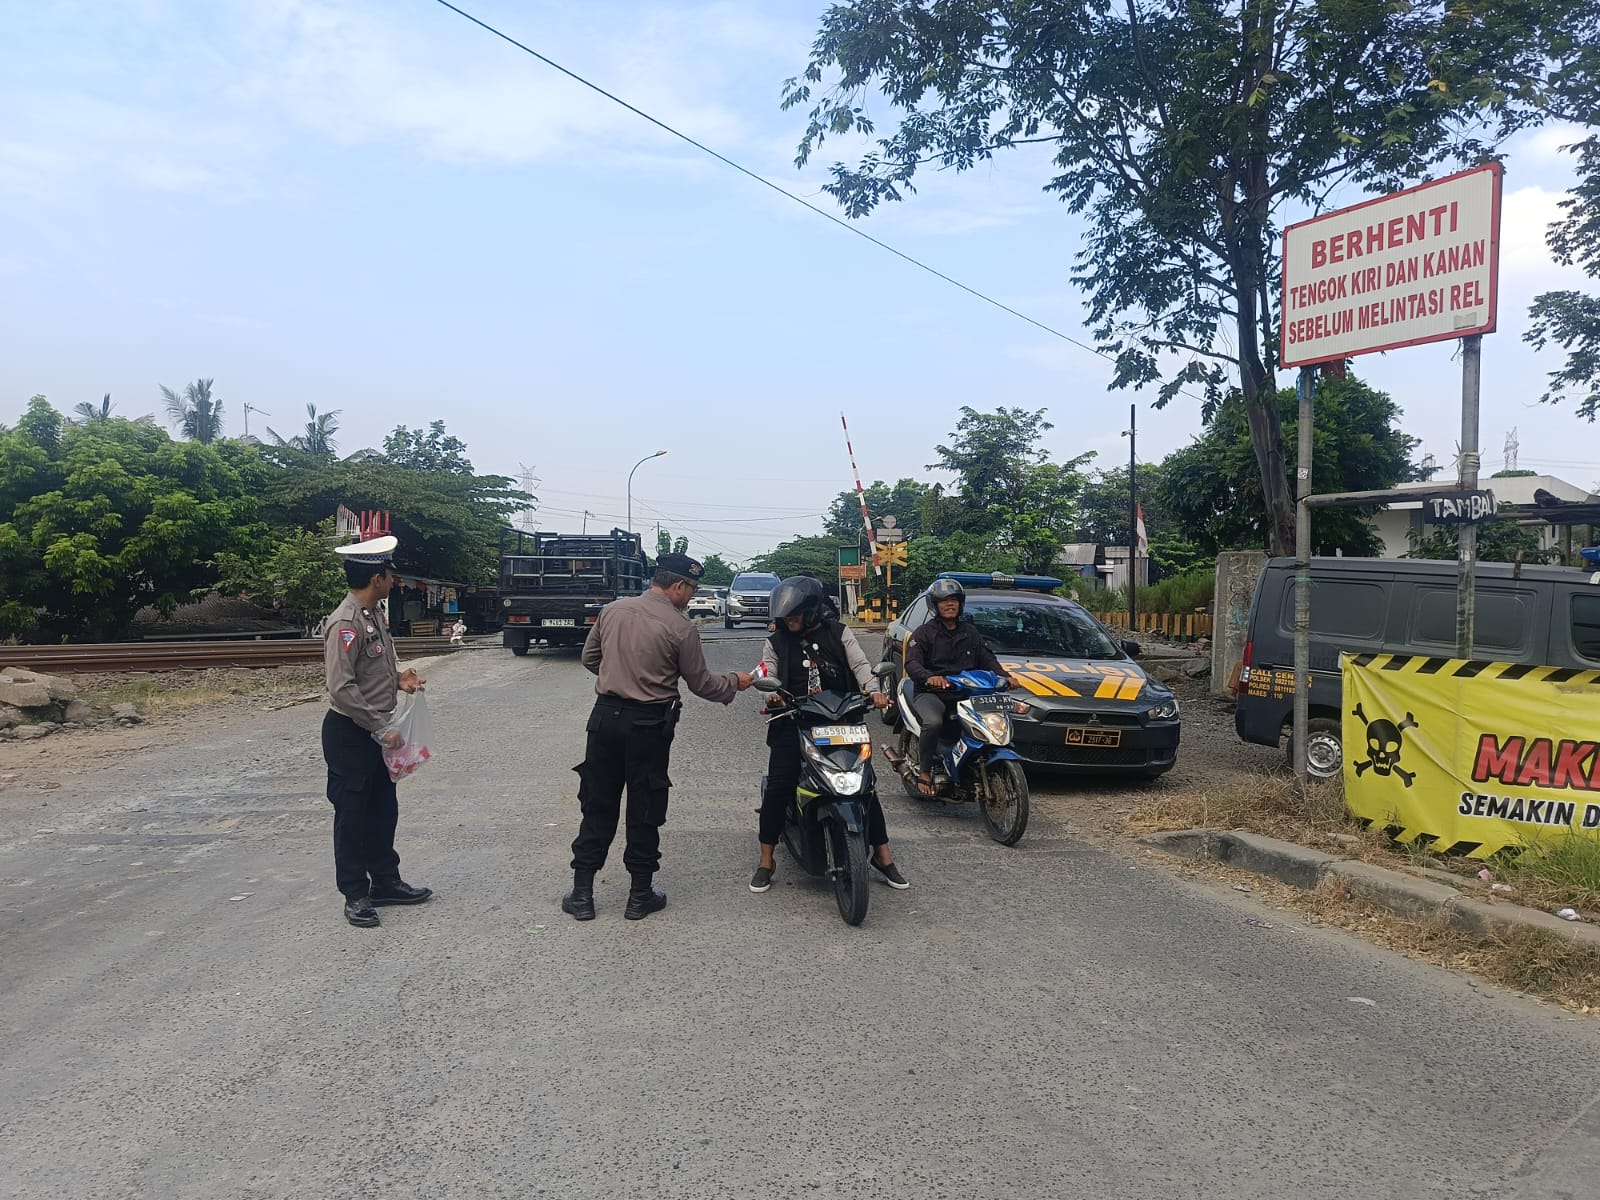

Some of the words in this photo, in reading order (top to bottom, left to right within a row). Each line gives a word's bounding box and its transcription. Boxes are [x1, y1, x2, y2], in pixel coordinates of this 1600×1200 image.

[1311, 201, 1458, 269] BERHENTI
[1290, 274, 1347, 310] TENGOK
[1351, 265, 1382, 295] KIRI
[1386, 256, 1418, 287] DAN
[1423, 239, 1486, 277] KANAN
[1288, 308, 1353, 344] SEBELUM
[1358, 288, 1444, 331] MELINTASI
[1450, 280, 1484, 311] REL
[999, 662, 1141, 678] POLISI
[1250, 668, 1273, 677] CALL
[1460, 793, 1574, 828] SEMAKIN
